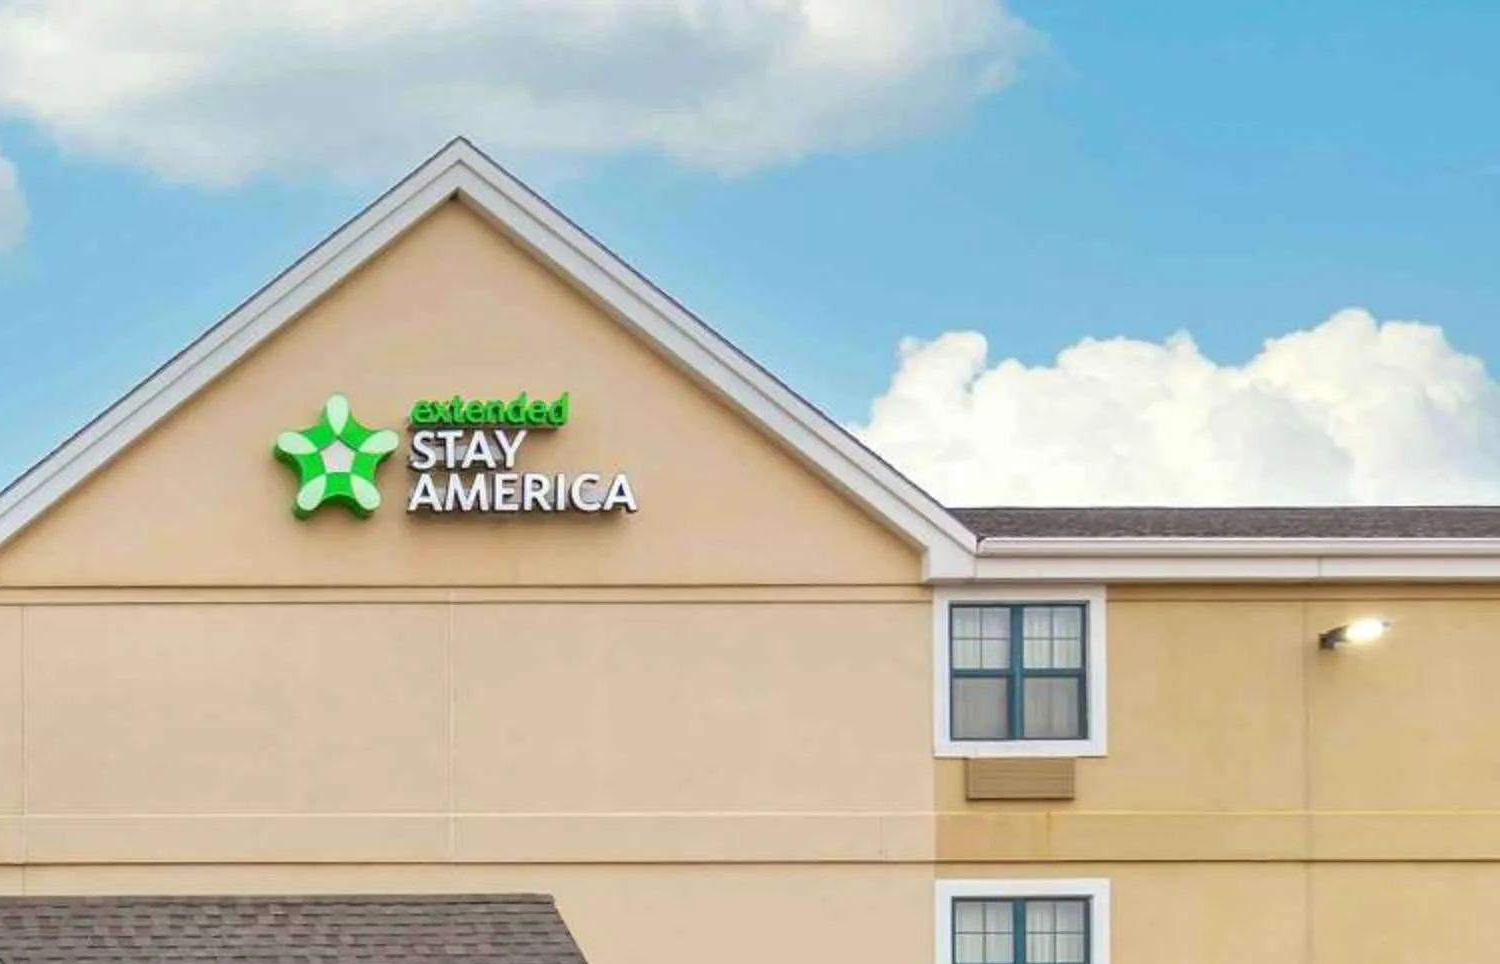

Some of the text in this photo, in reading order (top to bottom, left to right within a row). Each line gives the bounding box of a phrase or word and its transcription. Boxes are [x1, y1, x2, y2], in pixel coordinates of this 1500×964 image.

[411, 391, 569, 424] extended
[411, 430, 527, 469] STAY
[408, 473, 638, 511] AMERICA
